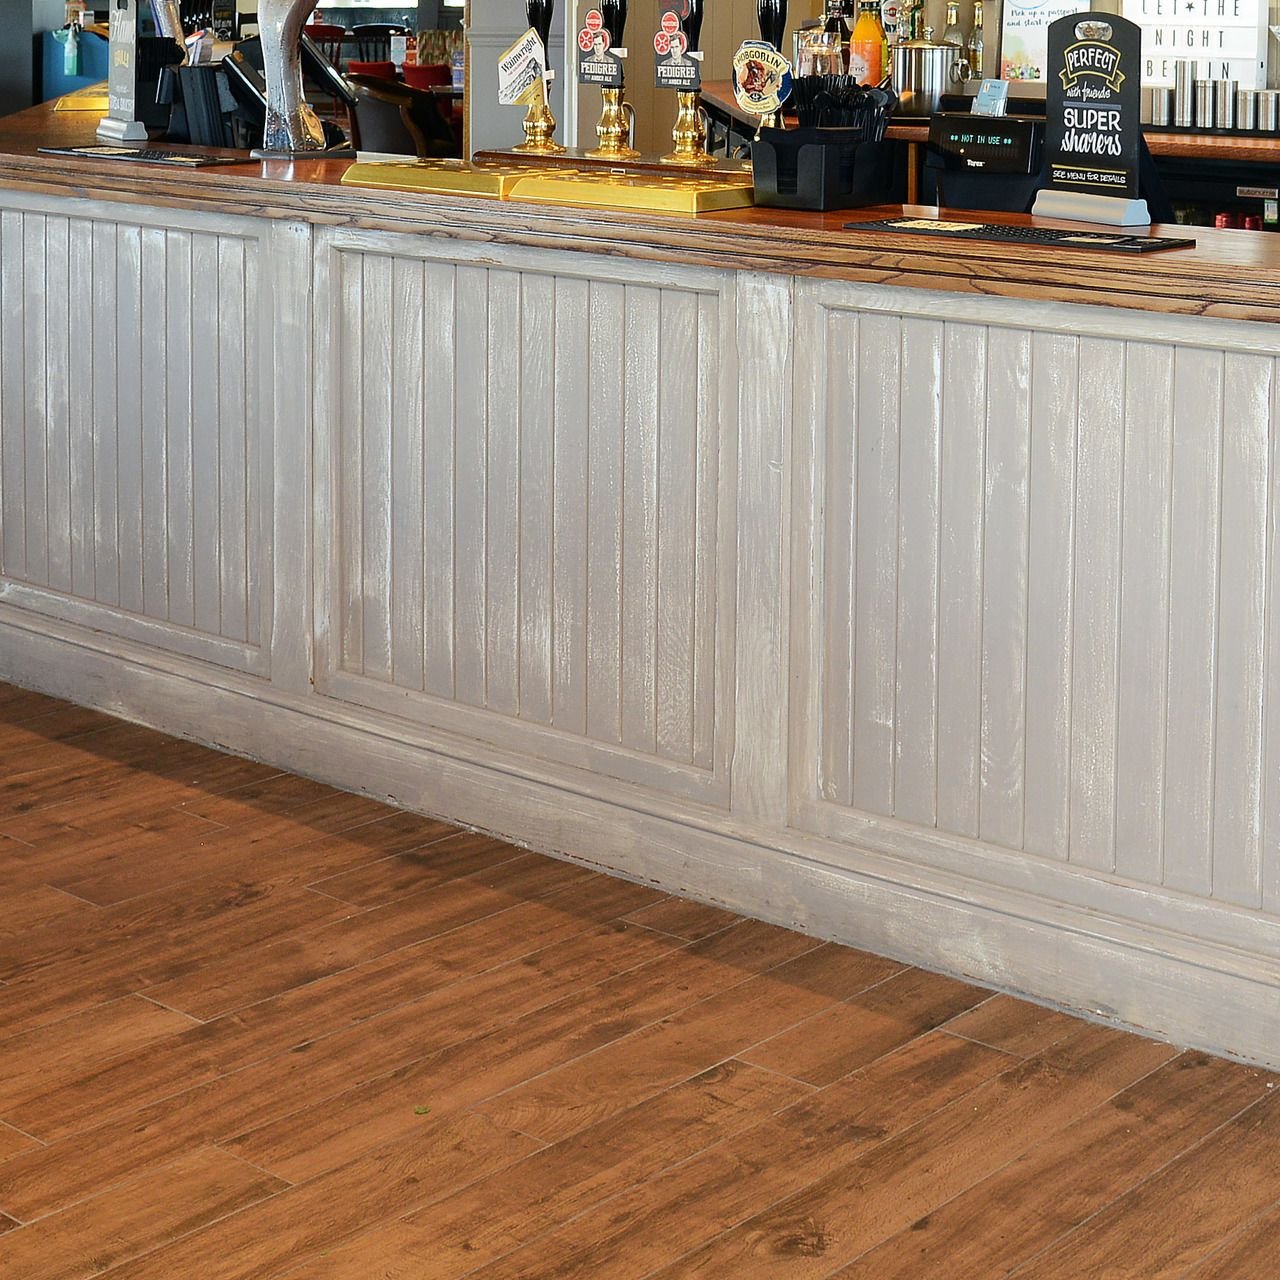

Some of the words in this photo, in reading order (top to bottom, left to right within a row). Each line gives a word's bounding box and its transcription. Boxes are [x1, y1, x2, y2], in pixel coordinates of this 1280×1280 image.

[1155, 29, 1225, 48] NIGHT
[500, 36, 538, 73] Wainwright
[1067, 48, 1117, 72] PERFECT
[580, 62, 618, 75] PEDIGREE
[657, 65, 696, 78] PEDIGREE
[1146, 60, 1230, 79] BEIN
[1066, 86, 1081, 99] with
[1081, 80, 1111, 102] friends
[1063, 108, 1122, 131] SUPER
[961, 134, 974, 143] NOT
[977, 135, 985, 144] IN
[988, 136, 1000, 144] USE
[1060, 128, 1121, 156] sharers
[1052, 170, 1065, 178] SEE
[1066, 171, 1085, 181] MENU
[1100, 173, 1126, 184] DETAILS
